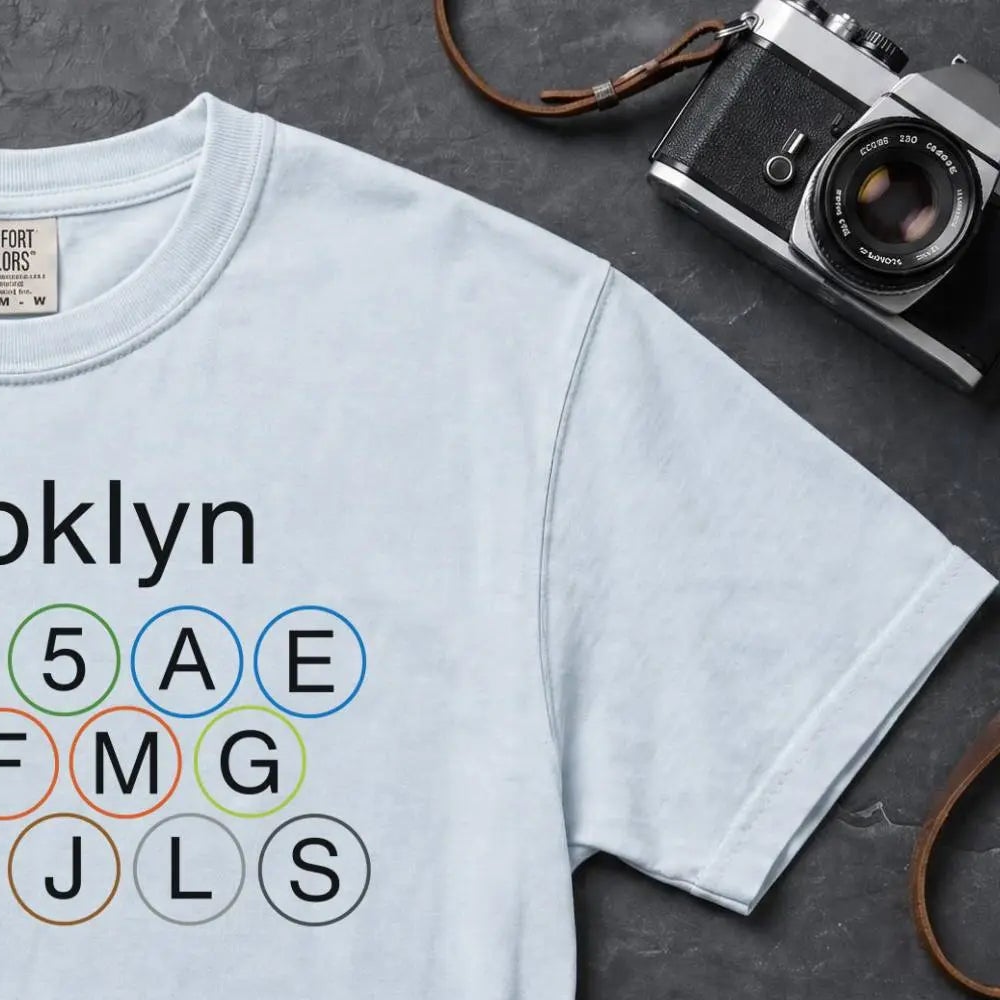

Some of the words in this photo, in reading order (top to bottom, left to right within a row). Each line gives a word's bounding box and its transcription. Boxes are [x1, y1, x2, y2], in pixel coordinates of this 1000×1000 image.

[34, 296, 46, 305] W
[43, 627, 86, 691] 5
[158, 628, 216, 690] A
[288, 630, 334, 693] E
[95, 731, 158, 794] M
[220, 729, 278, 795] G
[44, 836, 82, 900] J
[171, 837, 212, 899] L
[290, 837, 340, 903] S
